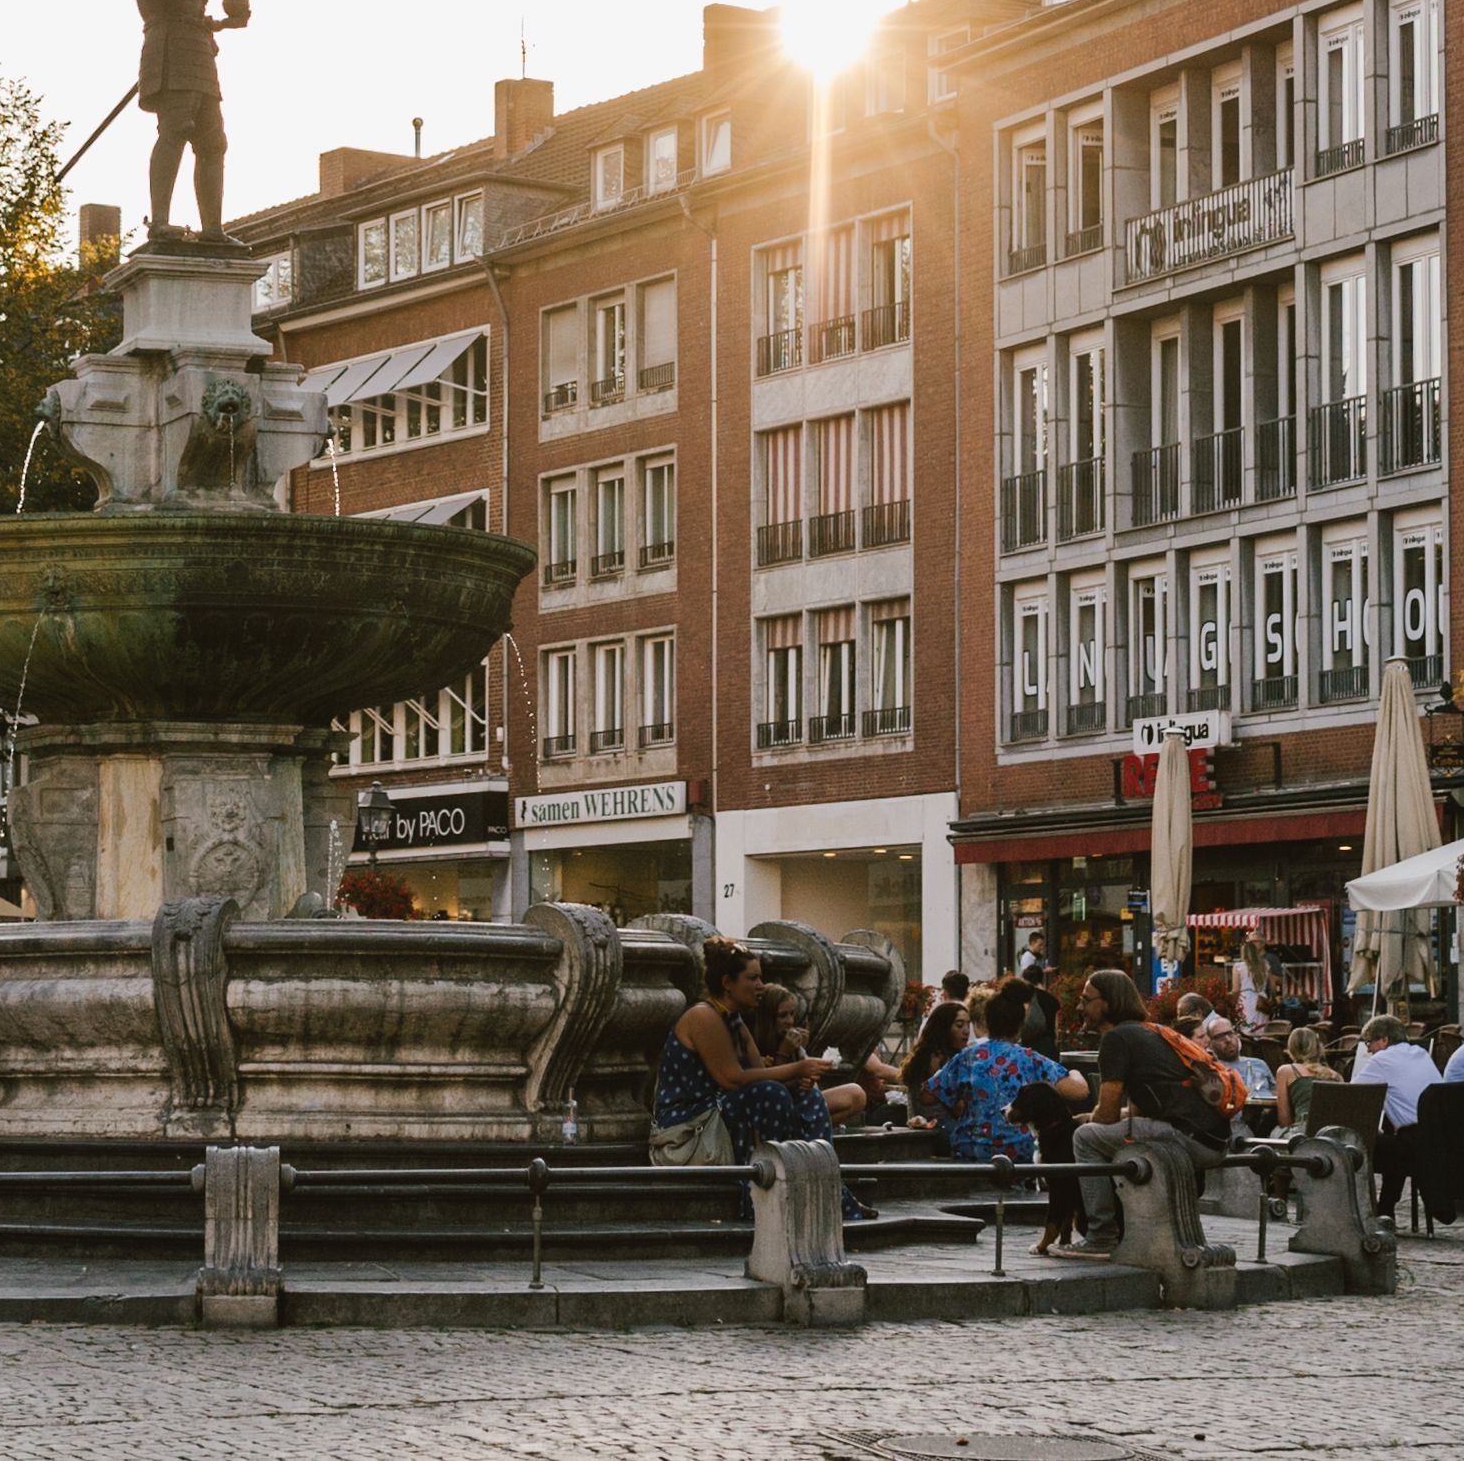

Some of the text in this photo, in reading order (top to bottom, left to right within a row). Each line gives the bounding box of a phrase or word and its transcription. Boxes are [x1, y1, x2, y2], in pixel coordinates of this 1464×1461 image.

[1173, 198, 1251, 243] inlingua
[1123, 748, 1211, 796] REE
[531, 784, 676, 825] samen WEHRENS
[397, 813, 417, 843] by
[419, 808, 465, 838] PACO
[488, 826, 507, 835] PACO
[723, 883, 735, 899] 27
